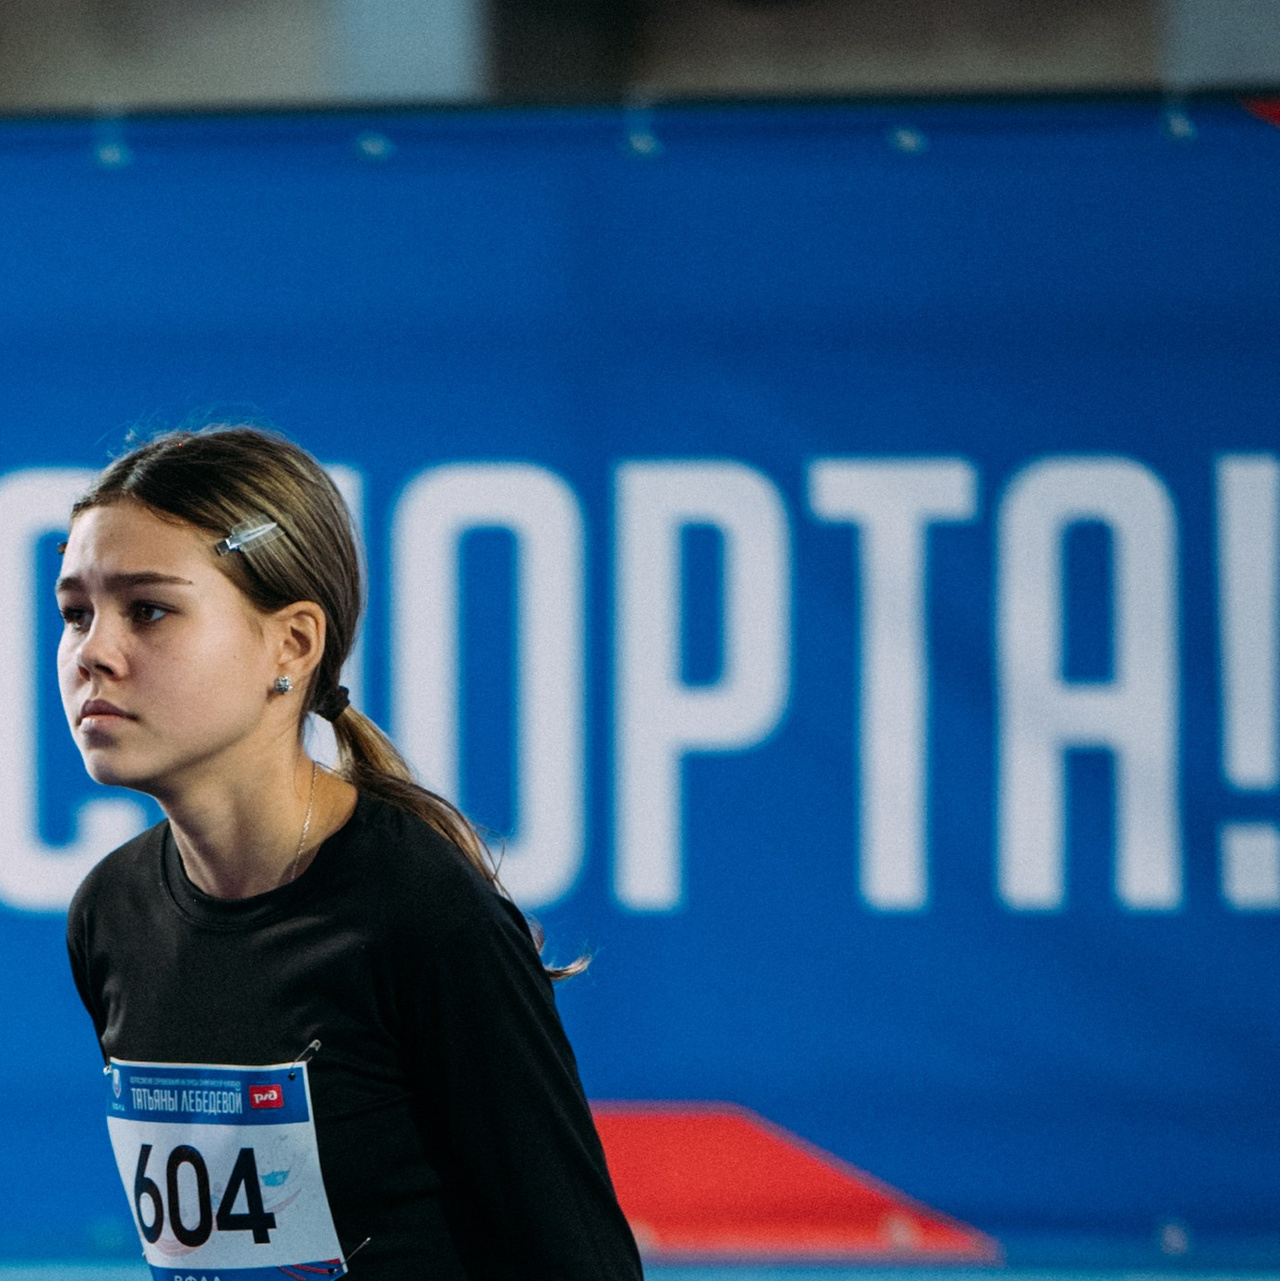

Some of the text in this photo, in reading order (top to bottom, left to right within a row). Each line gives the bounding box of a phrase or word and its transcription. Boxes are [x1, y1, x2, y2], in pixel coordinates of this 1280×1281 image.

[131, 1087, 243, 1115] ТАТЬЯНЫ ЛЕБЕДЕВОЙ
[134, 1143, 277, 1247] 604
